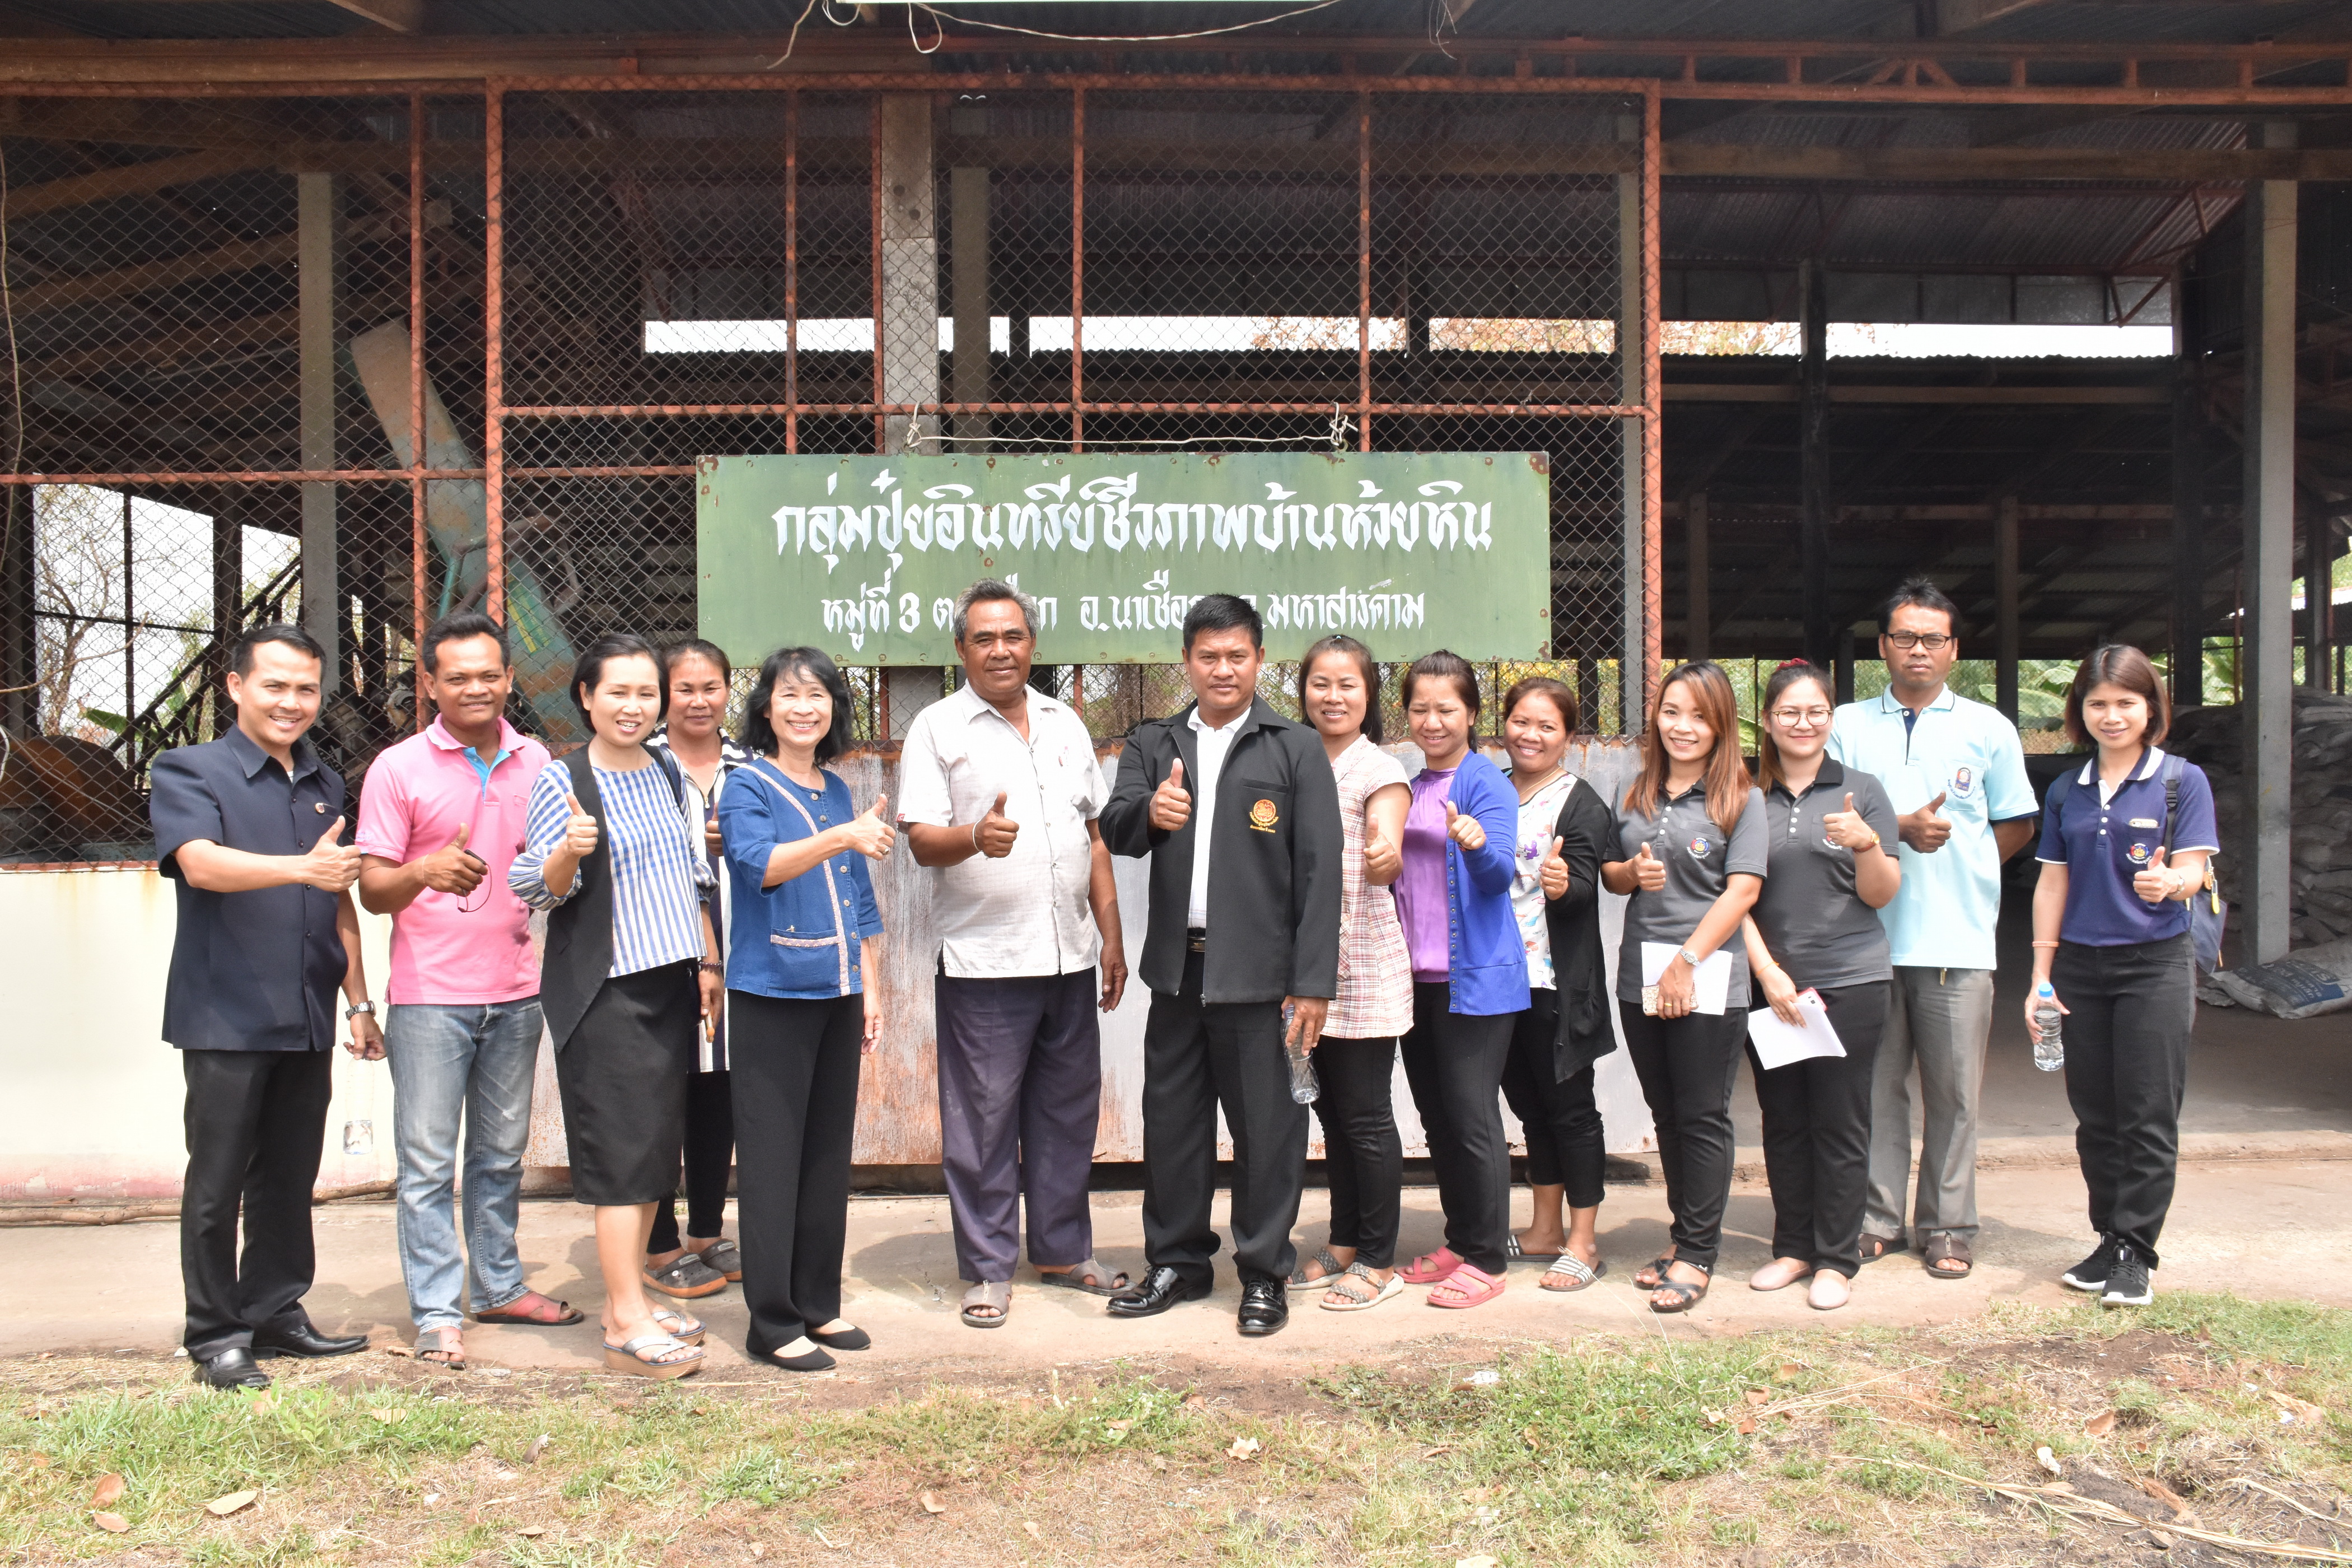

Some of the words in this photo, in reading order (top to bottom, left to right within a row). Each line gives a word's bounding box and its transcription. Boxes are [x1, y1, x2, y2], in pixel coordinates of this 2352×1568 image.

[820, 567, 892, 652] หมู่ที่
[899, 592, 920, 633] 3
